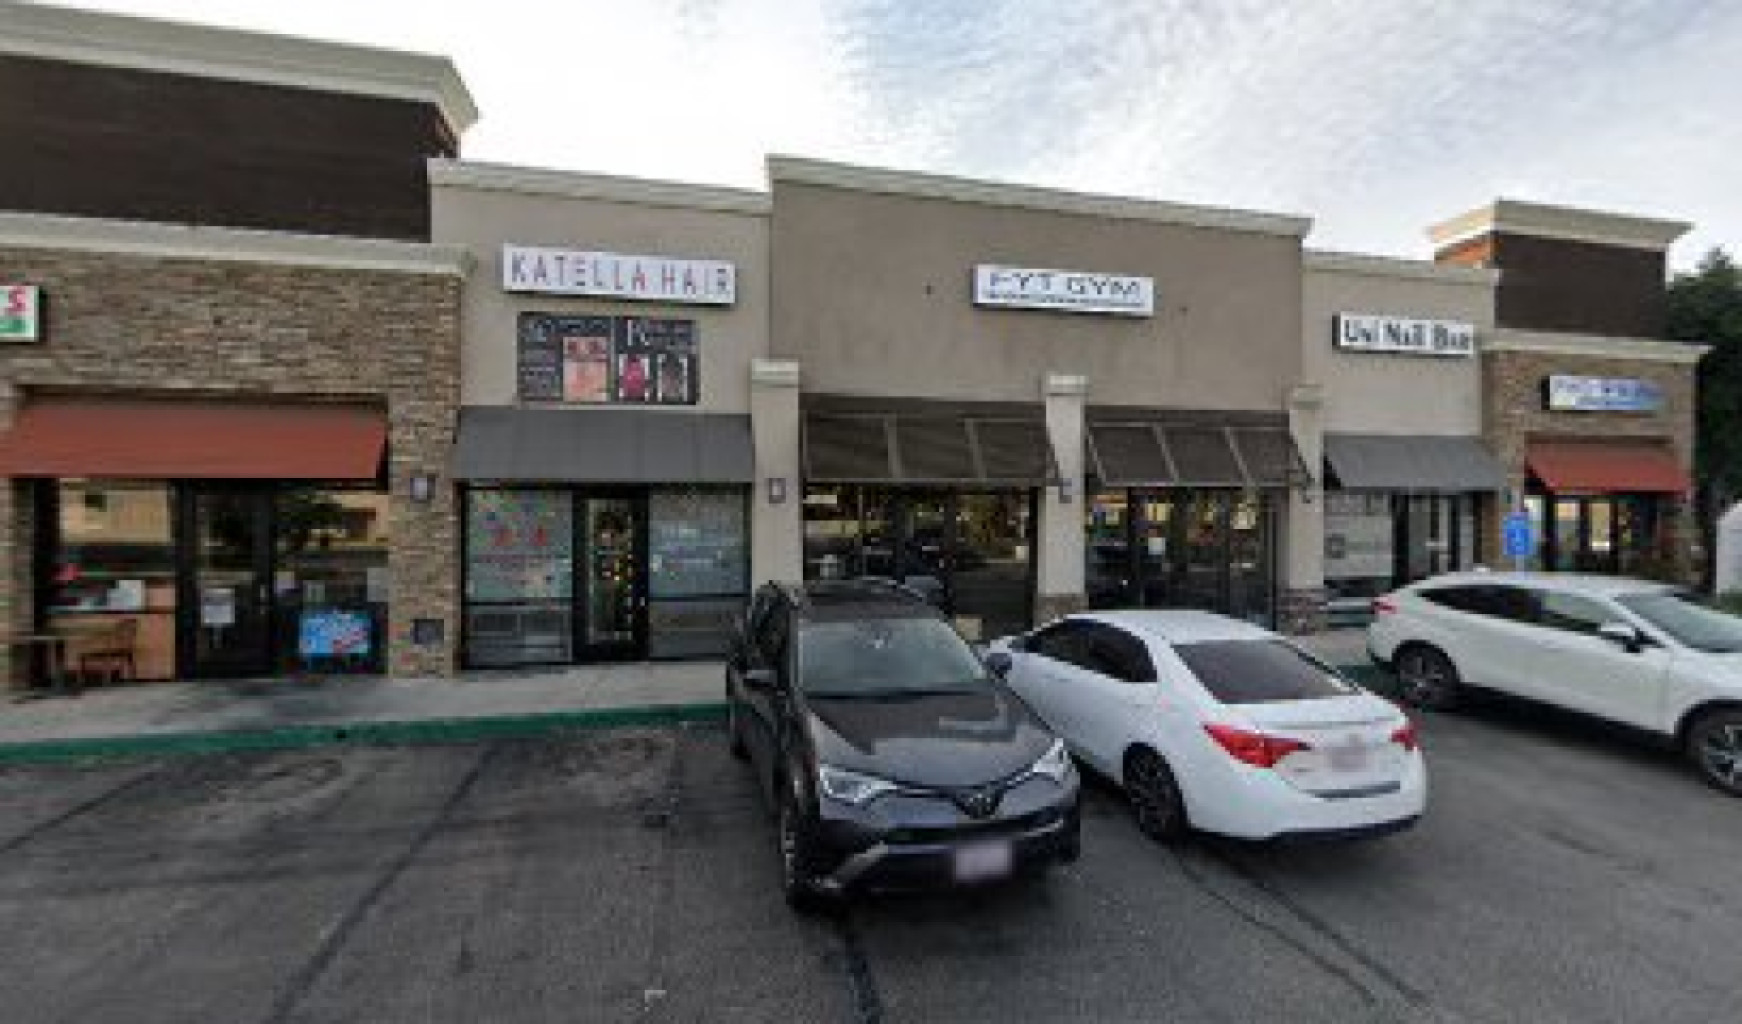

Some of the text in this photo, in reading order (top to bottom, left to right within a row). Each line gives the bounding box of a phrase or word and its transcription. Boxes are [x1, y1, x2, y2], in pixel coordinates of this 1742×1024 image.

[510, 250, 728, 296] KATELLA HAIR
[1066, 276, 1141, 297] GYM
